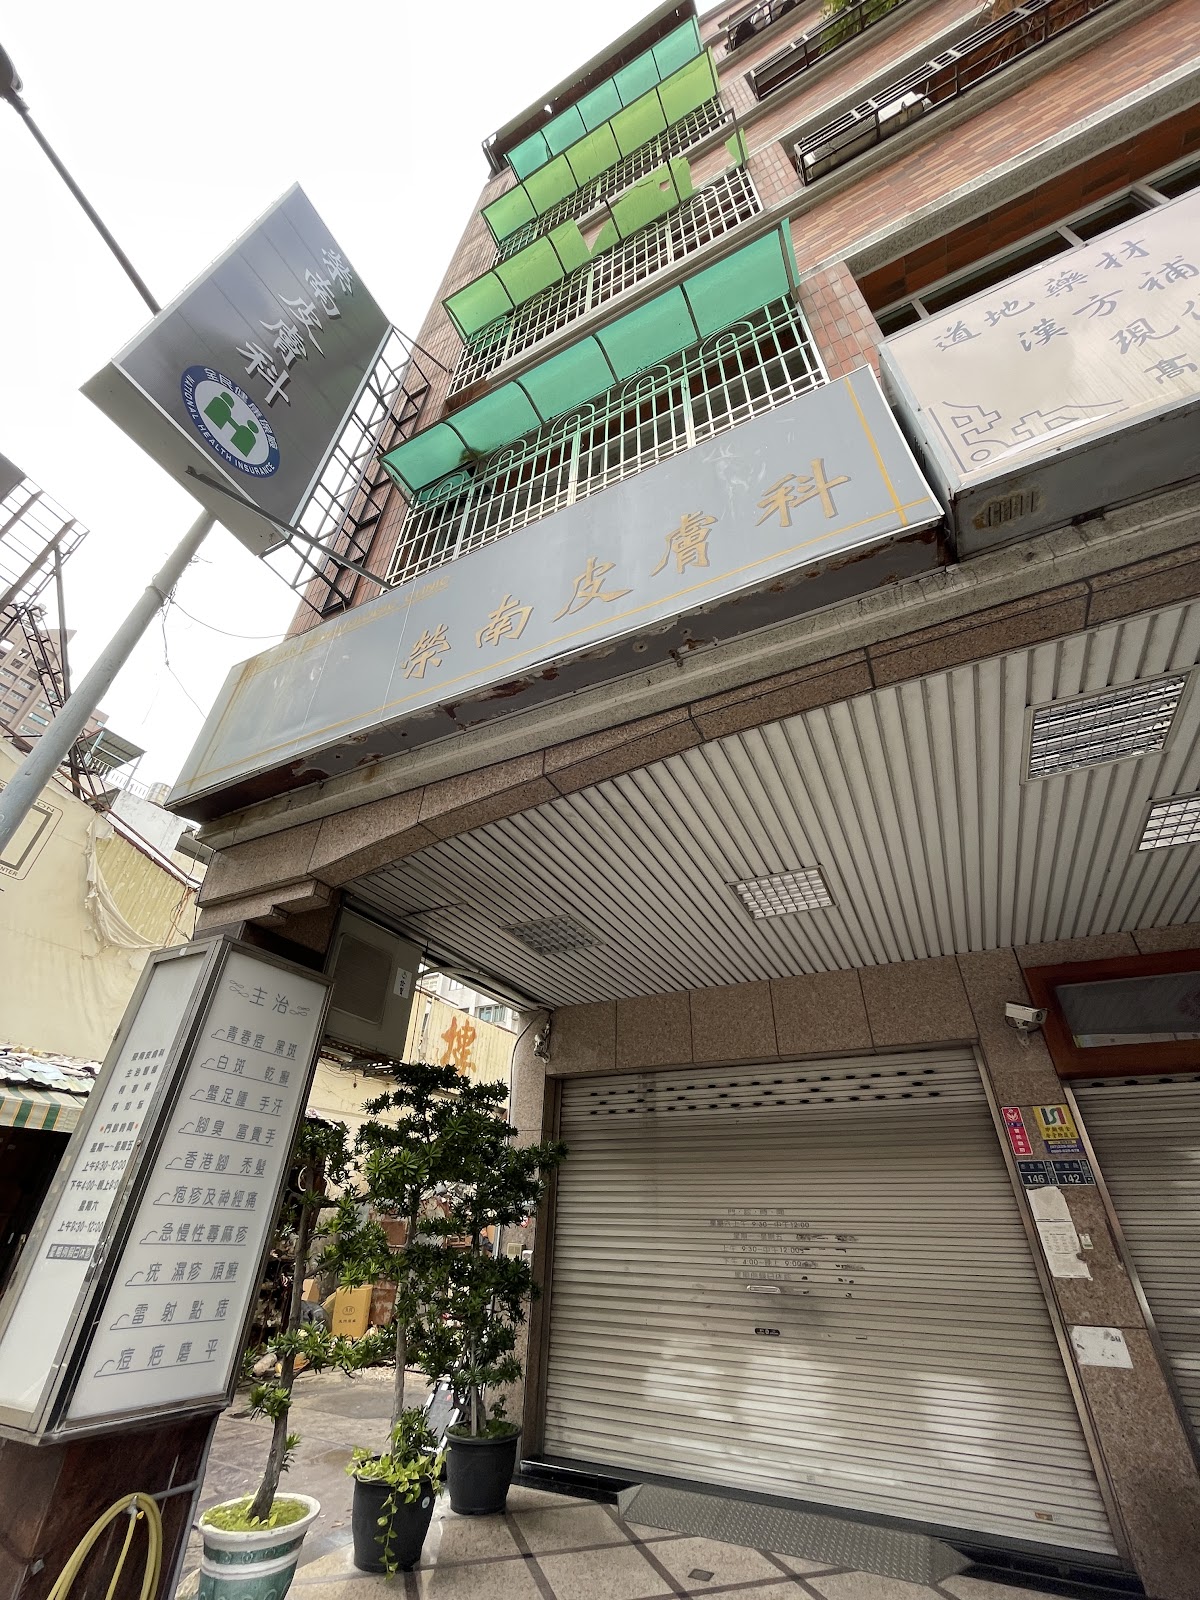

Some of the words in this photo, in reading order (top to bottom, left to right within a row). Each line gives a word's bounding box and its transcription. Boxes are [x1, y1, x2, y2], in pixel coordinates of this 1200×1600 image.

[932, 239, 1150, 351] 道地藥材
[236, 248, 354, 406] 榮南皮膚科
[184, 374, 200, 420] NATIONAL
[197, 423, 233, 462] HEALTH
[234, 459, 275, 475] INSURANCE
[400, 457, 851, 679] 榮南皮膚科
[249, 986, 289, 1014] 主治
[226, 1025, 266, 1049] 青春痘
[274, 1039, 298, 1058] 黑斑
[216, 1055, 247, 1075] 白斑
[205, 1084, 249, 1107] 蟹足腫
[259, 1096, 283, 1114] 手汗
[195, 1116, 224, 1136] 腳臭
[236, 1123, 276, 1144] 富貴手
[184, 1151, 229, 1172] 香港腳
[240, 1157, 266, 1176] 禿髮
[1027, 1174, 1044, 1183] 146
[1063, 1174, 1080, 1183] 142
[78, 1200, 99, 1211] 星期六
[159, 1222, 248, 1243] 急慢性蕁麻疹
[171, 1261, 202, 1282] 濕疹
[210, 1261, 239, 1280] 頑癬
[131, 1298, 229, 1325] 雷射點痣
[116, 1339, 218, 1371] 痘疤磨平
